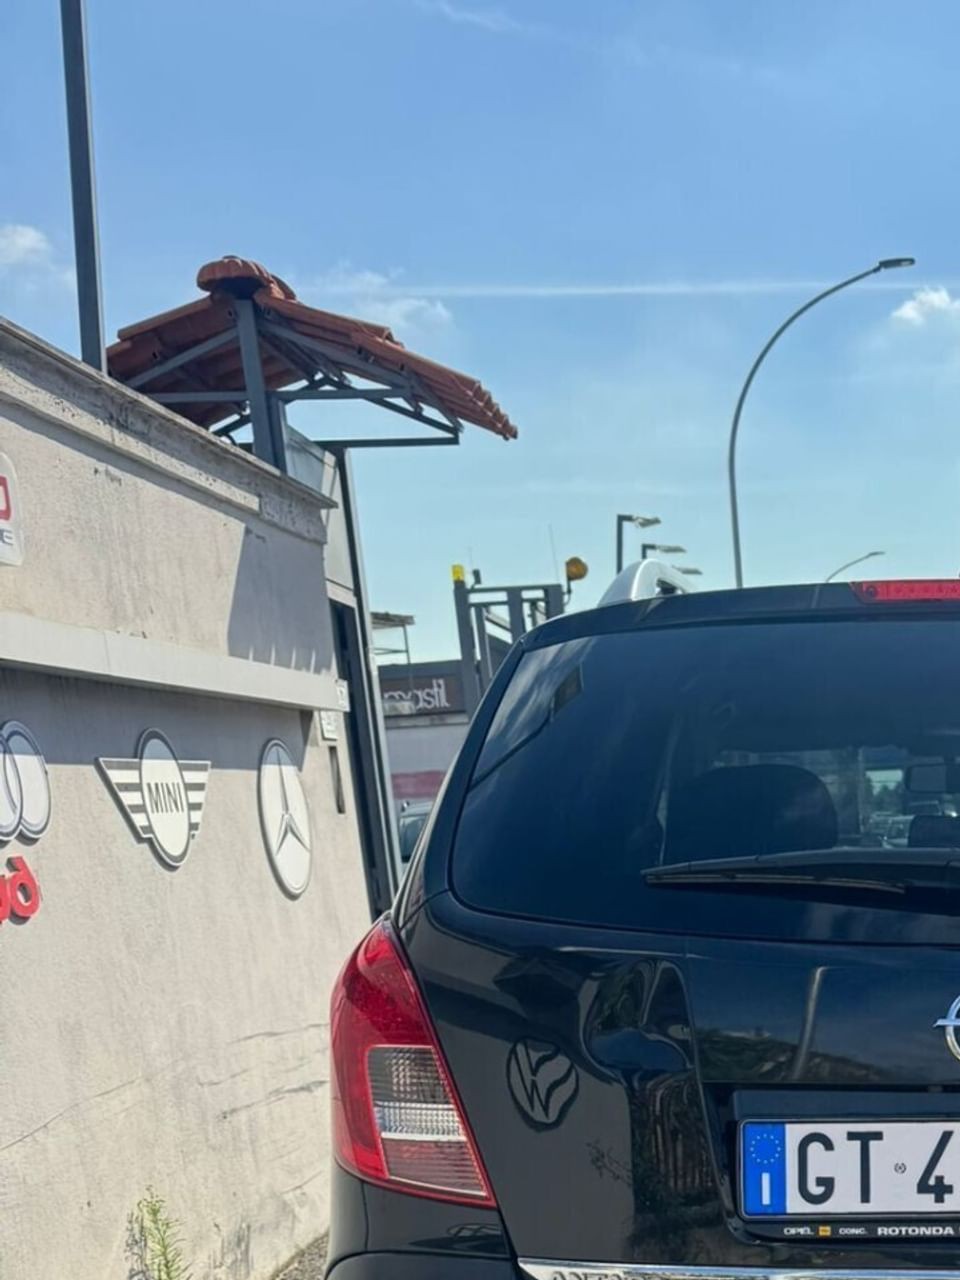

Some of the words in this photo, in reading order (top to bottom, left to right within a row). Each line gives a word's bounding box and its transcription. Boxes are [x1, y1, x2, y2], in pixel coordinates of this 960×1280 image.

[146, 782, 184, 814] MINI
[798, 1131, 884, 1205] GT
[877, 1226, 954, 1236] ROTONDA
